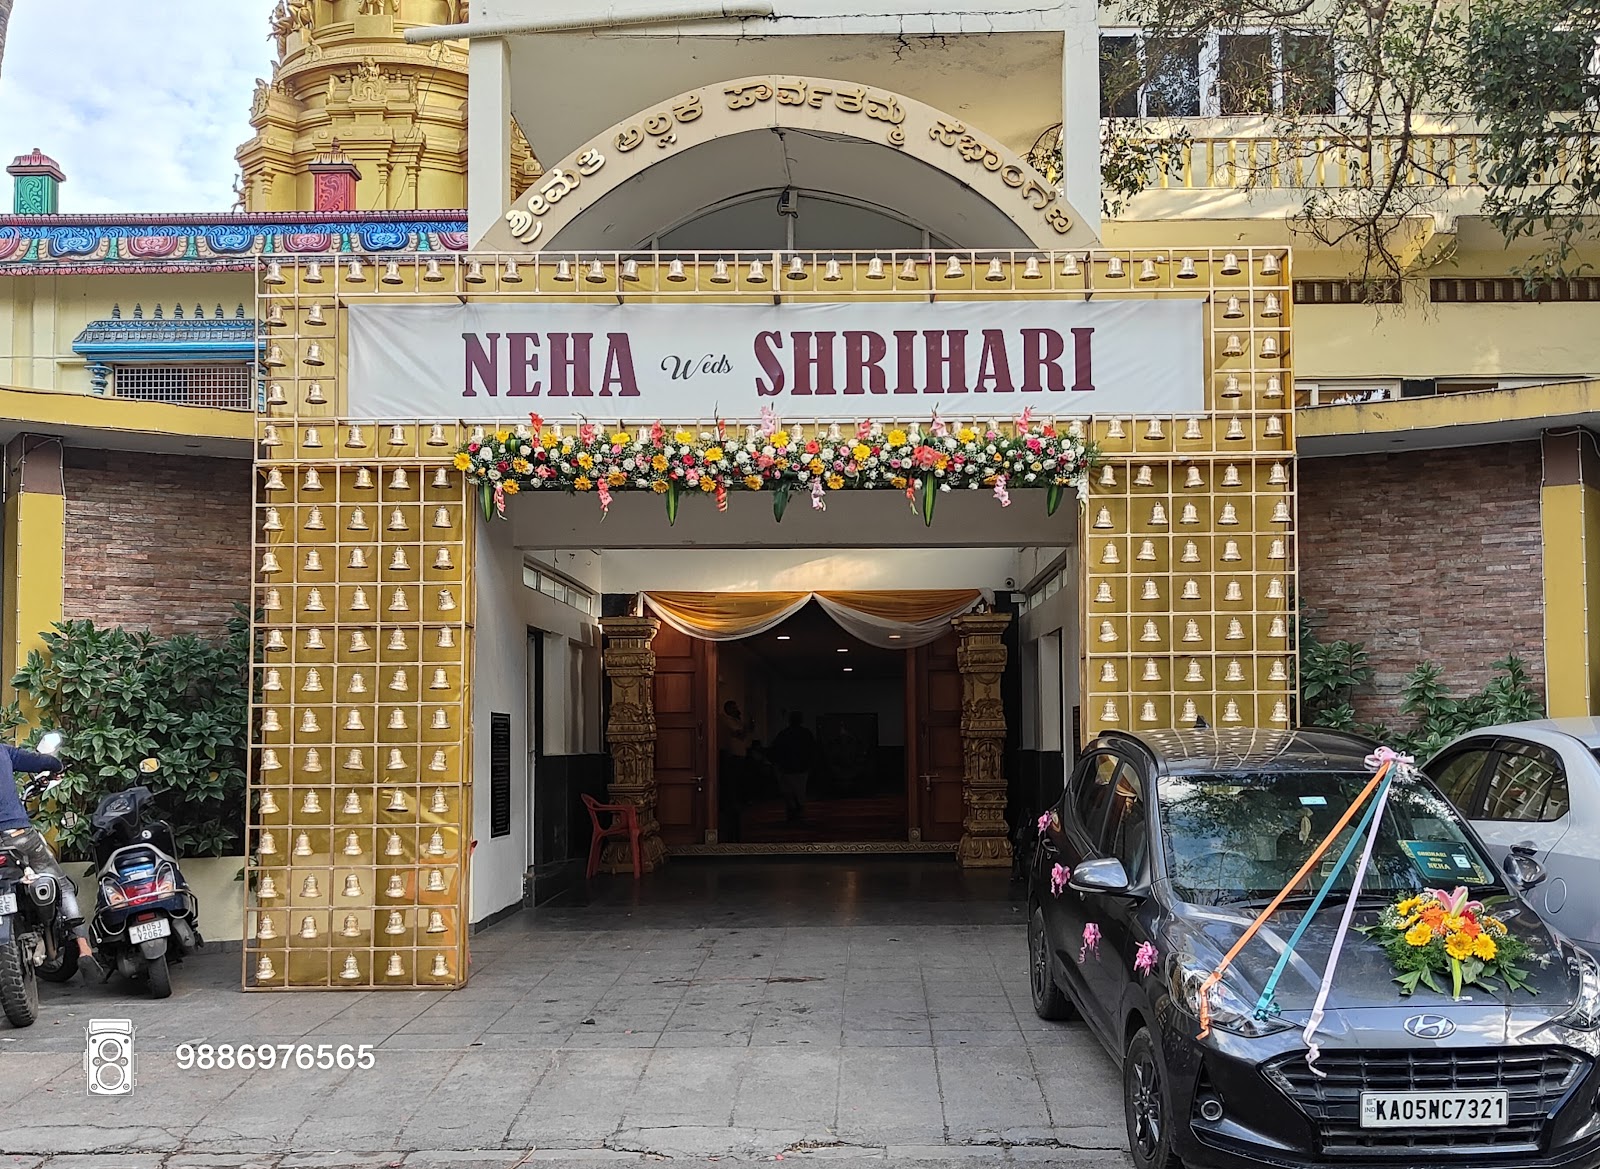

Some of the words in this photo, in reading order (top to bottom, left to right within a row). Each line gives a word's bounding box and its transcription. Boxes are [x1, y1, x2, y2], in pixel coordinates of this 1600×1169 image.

[724, 79, 906, 146] ಪಾರ್ವತಮ್ಮ
[929, 118, 1073, 234] ಸಭಾಂಗಣ
[461, 332, 641, 397] NEHA
[660, 353, 734, 380] Weds
[755, 327, 1095, 397] SHRIHARI
[136, 921, 162, 934] KA05J
[138, 928, 163, 941] V2062
[1376, 1098, 1503, 1120] KA05NC7321
